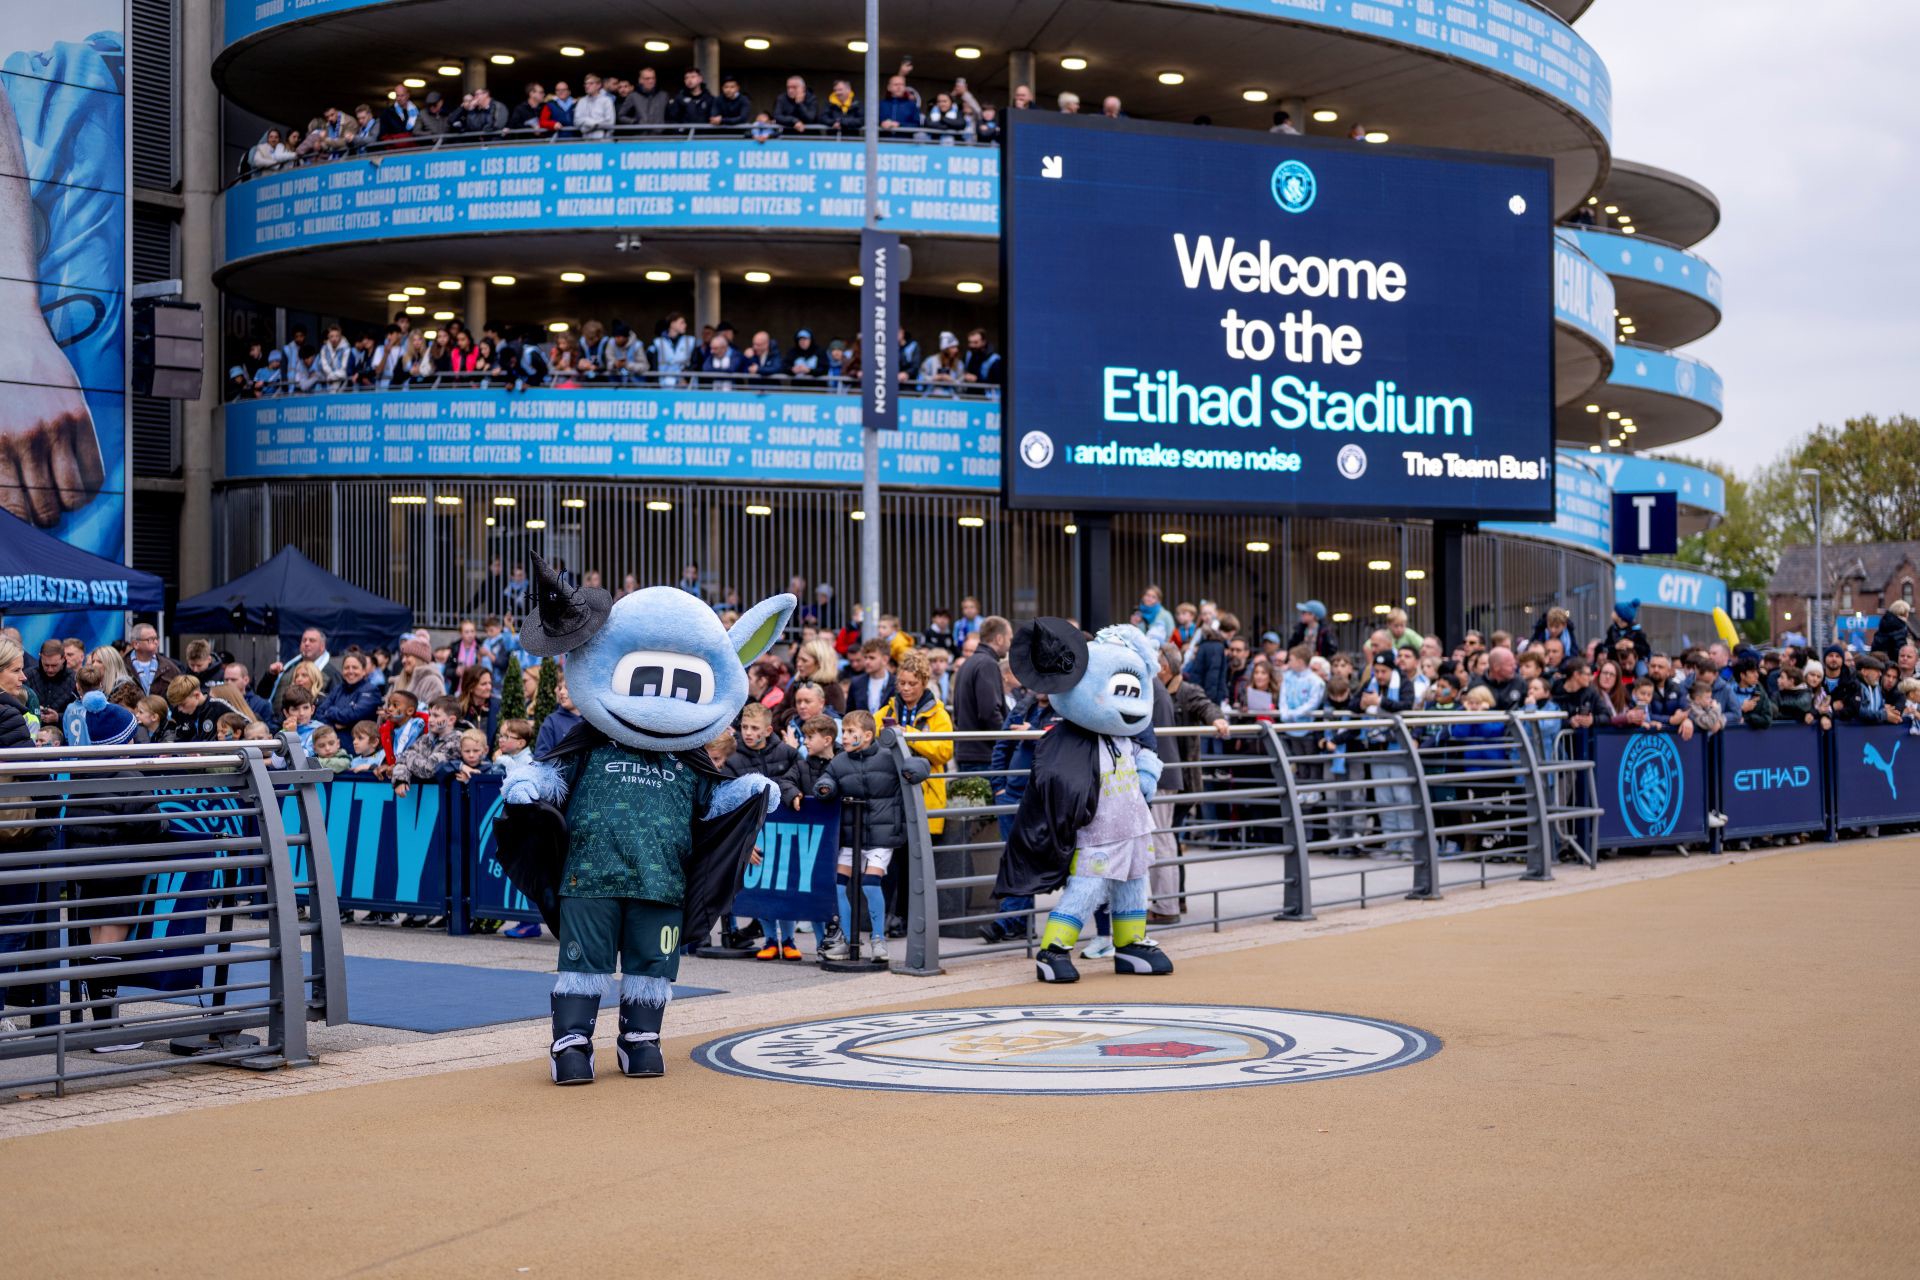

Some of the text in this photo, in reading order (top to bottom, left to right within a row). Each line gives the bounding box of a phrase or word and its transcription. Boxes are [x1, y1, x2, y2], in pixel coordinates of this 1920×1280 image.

[328, 169, 364, 189] LIMERICK
[376, 164, 411, 184] LINCOLN
[425, 160, 466, 179] LISBURN
[480, 157, 504, 175] LISS
[506, 155, 540, 174] BLUES
[557, 152, 603, 172] LONDON
[620, 151, 677, 170] LOUDOUN
[679, 150, 720, 169] BLUES
[738, 150, 790, 169] LUSAKA
[809, 151, 853, 170] LYMM
[855, 153, 865, 171] &
[294, 197, 318, 216] MARPLE
[320, 194, 342, 213] BLUES
[355, 188, 396, 207] MASHHAD
[398, 184, 440, 204] CITYZENS
[457, 180, 497, 199] MCWFC
[499, 178, 544, 197] BRANCH
[564, 175, 613, 194] MELAKA
[634, 173, 710, 193] MELBOURNE
[734, 173, 816, 193] MERSEYSIDE
[890, 176, 946, 197] DETROIT
[948, 179, 991, 199] BLUES
[303, 214, 344, 236] MILWAUKEE
[345, 211, 381, 229] CITYZENS
[392, 205, 454, 226] MINNEAPOLIS
[468, 200, 541, 221] MISSISSAUGA
[557, 198, 615, 217] MIZORAM
[617, 196, 674, 215] CITYZENS
[691, 196, 739, 215] MONGU
[741, 197, 802, 216] CITYZENS
[1173, 233, 1407, 303] Welcome
[874, 248, 886, 414] WEST RECEPTION
[1221, 309, 1363, 365] to the
[283, 405, 318, 423] PICCADILLY
[325, 404, 371, 422] PITTSBURGH
[382, 401, 438, 420] PORTADOWN
[450, 400, 496, 419] POYNTON
[509, 400, 574, 419] PRESTWICH
[576, 400, 585, 419] &
[587, 400, 658, 420] WHITEFIELD
[674, 401, 715, 420] PULAU
[717, 402, 766, 421] PINANG
[782, 404, 818, 423] PUNE
[912, 408, 968, 430] RALEIGH
[1103, 367, 1474, 436] Etihad Stadium
[313, 426, 347, 443] SHENZHEN
[349, 424, 373, 442] BLUES
[384, 423, 425, 441] SHILLONG
[426, 423, 471, 441] CITYZENS
[484, 422, 559, 441] SHREWSBURY
[574, 423, 649, 442] SHROPSHIRE
[664, 424, 710, 443] SIERRA
[712, 425, 752, 444] LEONE
[768, 426, 842, 447] SINGAPORE
[905, 431, 960, 452] FLORIDA
[290, 448, 317, 464] CITYZENS
[328, 446, 353, 464] TAMPA
[354, 446, 371, 463] BAY
[428, 445, 471, 463] TENERIFE
[473, 445, 521, 464] CITYZENS
[539, 445, 613, 464] TERENGGANU
[632, 446, 683, 465] THAMES
[685, 447, 731, 467] VALLEY
[751, 448, 811, 469] TLEMCEN
[897, 453, 940, 475] TOKYO
[1074, 440, 1118, 465] and
[1119, 442, 1181, 468] make
[1182, 449, 1245, 470] some
[1245, 446, 1302, 471] noise
[1402, 451, 1443, 477] The
[1443, 453, 1499, 479] Team
[1499, 455, 1540, 480] Bus
[1632, 496, 1656, 550] T
[90, 579, 128, 605] CITY
[1658, 574, 1702, 606] CITY
[1731, 591, 1746, 619] R
[605, 761, 676, 782] ETIHAD
[620, 775, 662, 789] AIRWAYS
[1733, 766, 1810, 792] ETIHAD
[1649, 817, 1667, 837] CITY
[756, 1008, 1125, 1069] MANCHESTER
[1239, 1047, 1380, 1076] CITY
